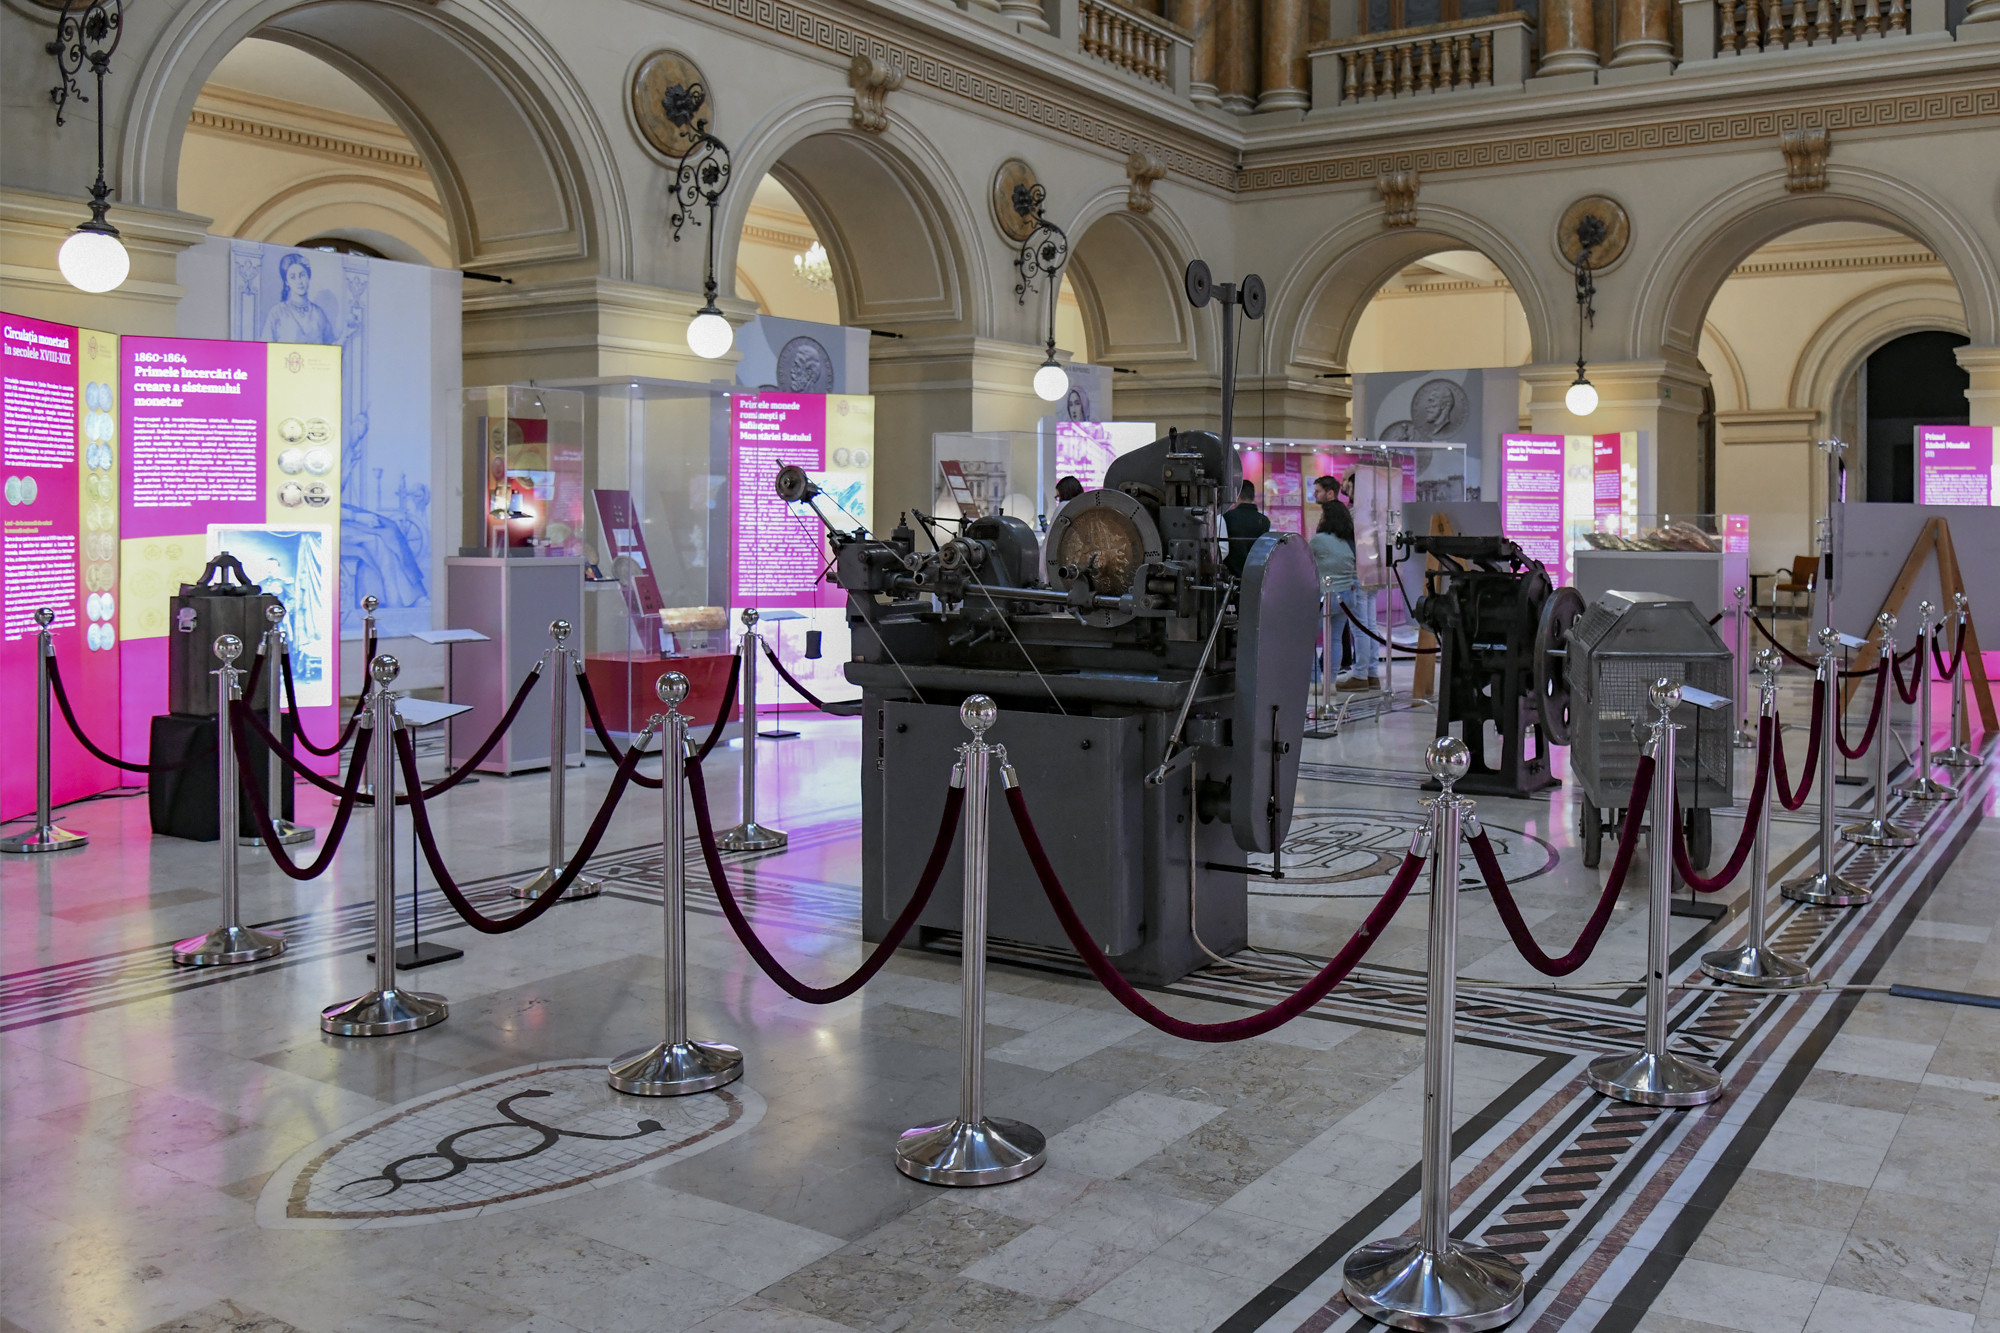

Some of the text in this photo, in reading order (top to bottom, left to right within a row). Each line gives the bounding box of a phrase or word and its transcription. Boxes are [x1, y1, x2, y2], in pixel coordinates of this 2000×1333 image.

[4, 326, 69, 349] Circulația monetară
[12, 346, 39, 360] secolele
[39, 348, 71, 365] XVIII-XIX
[134, 352, 187, 364] 1860-1864
[134, 365, 248, 380] Primele încercări de
[134, 381, 241, 394] creare a sistemului
[134, 397, 184, 407] monetar
[770, 402, 800, 410] monede
[782, 433, 811, 441] Statului
